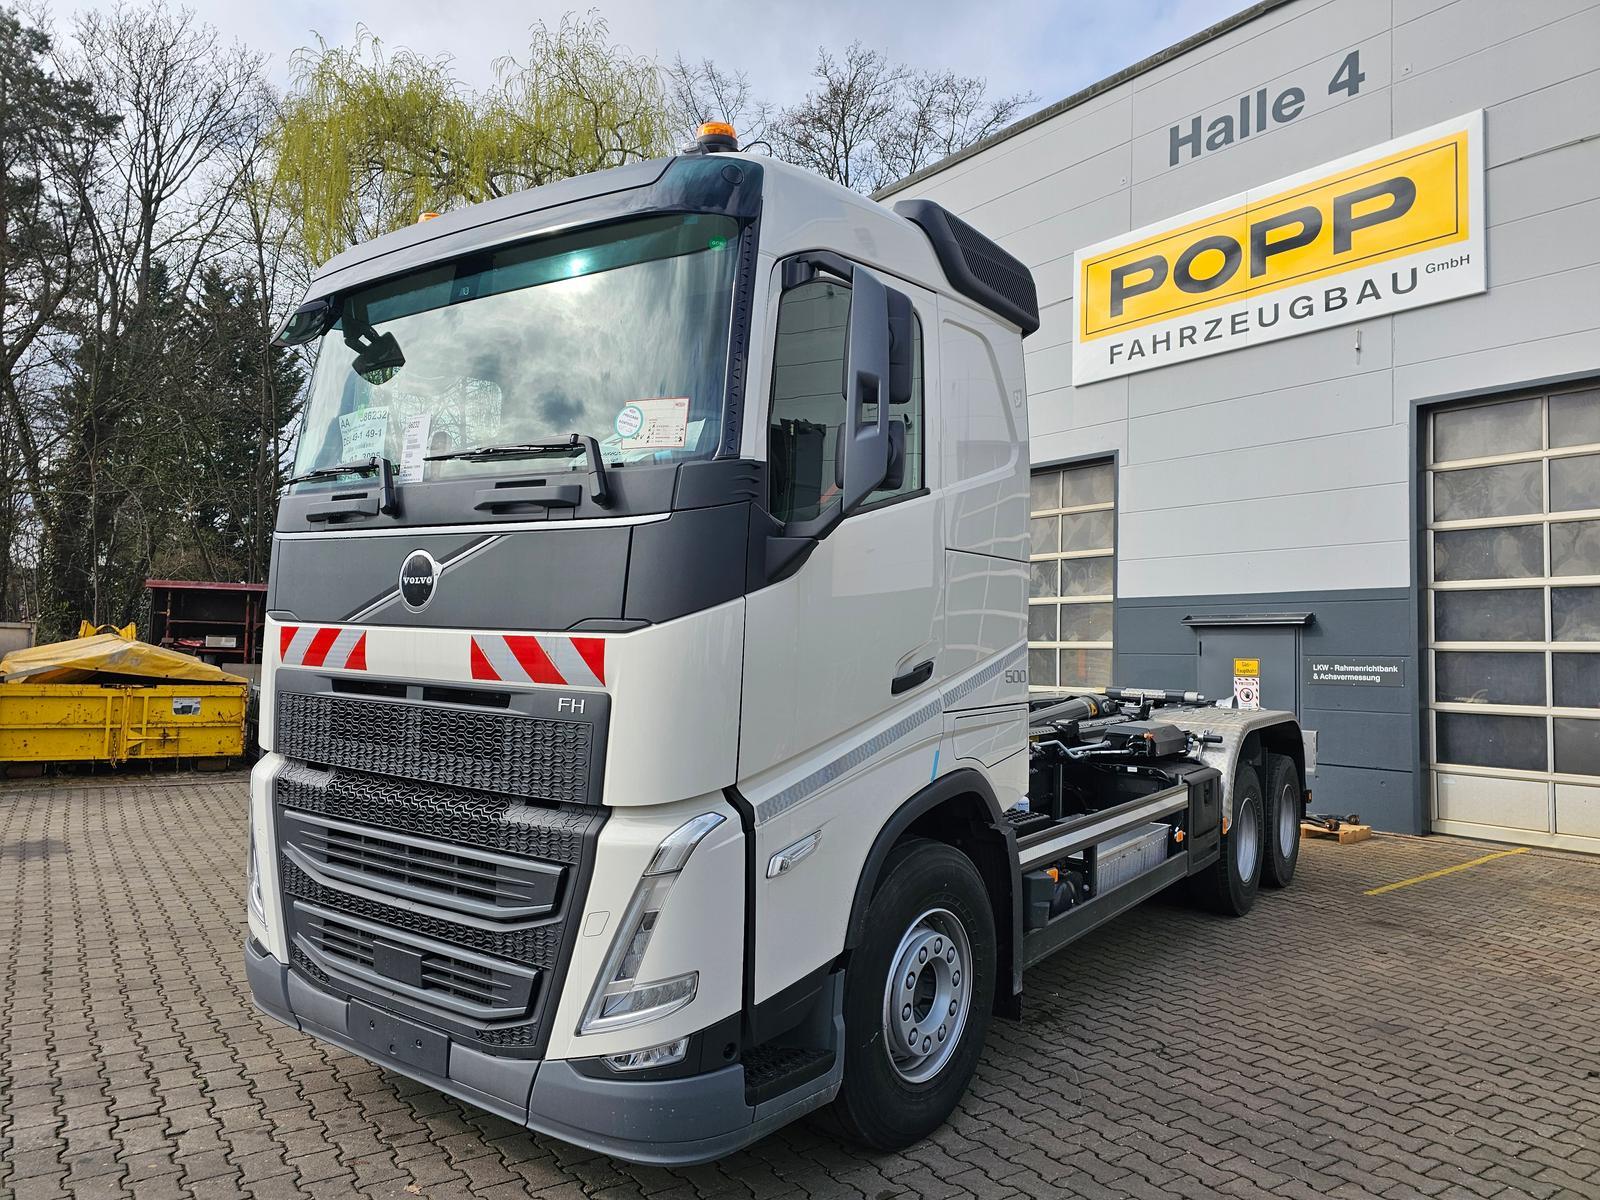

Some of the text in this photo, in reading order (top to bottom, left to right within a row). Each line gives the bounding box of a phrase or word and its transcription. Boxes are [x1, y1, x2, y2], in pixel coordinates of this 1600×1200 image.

[1169, 50, 1365, 168] Halle 4
[1110, 176, 1417, 318] POPP
[1425, 254, 1471, 274] GmbH
[1109, 267, 1419, 365] FAHRZEUGBAU
[403, 576, 432, 585] VOLVO
[1005, 669, 1026, 684] 500
[1334, 664, 1398, 673] Rahmenrichtbank
[1320, 673, 1381, 683] Achsvermessung
[557, 697, 585, 714] FH
